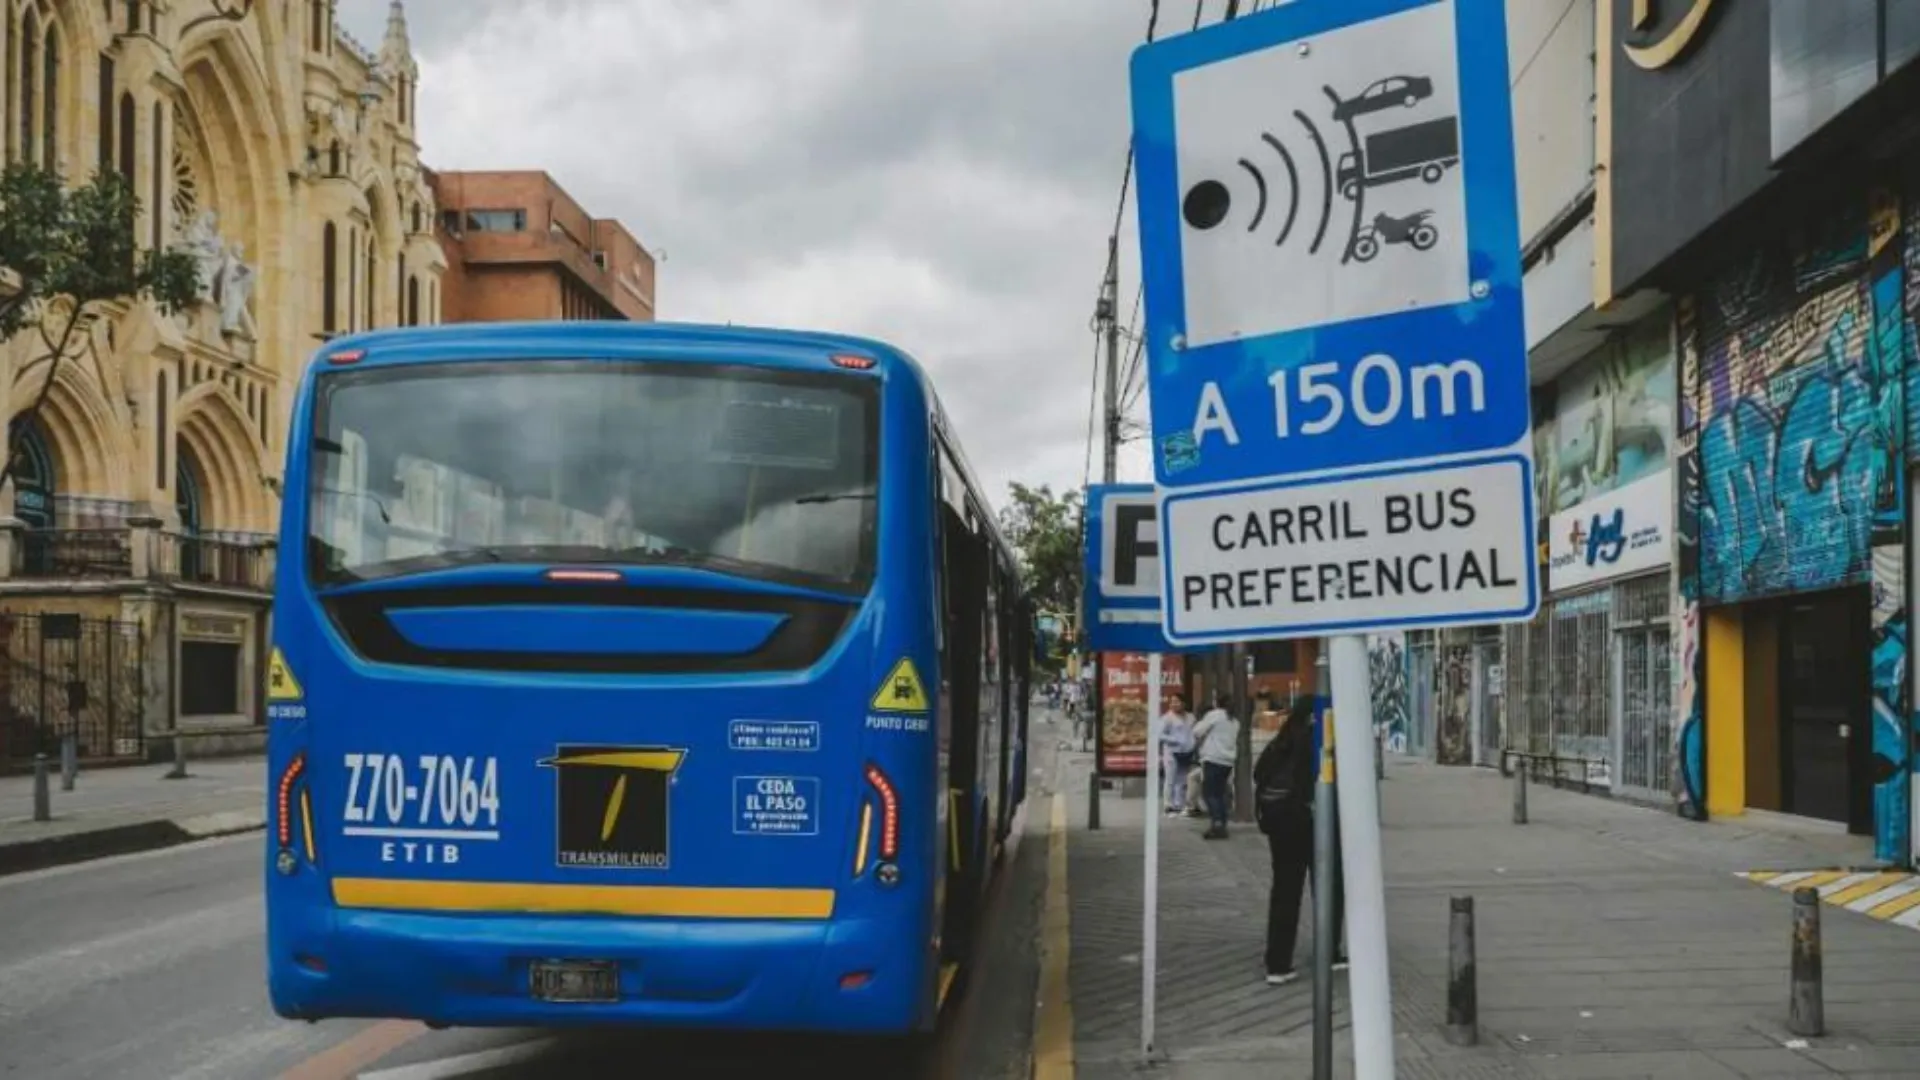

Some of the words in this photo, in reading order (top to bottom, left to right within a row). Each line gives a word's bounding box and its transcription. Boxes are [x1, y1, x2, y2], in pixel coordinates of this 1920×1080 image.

[1193, 382, 1239, 445] A
[1267, 353, 1484, 438] 150m
[1212, 501, 1368, 551] CARRIL
[1385, 487, 1476, 535] BUS
[1183, 548, 1518, 612] PREFERENCIAL
[865, 715, 902, 730] PUNTO
[344, 754, 499, 824] Z70-7064
[757, 780, 795, 795] CEDA
[746, 795, 762, 811] EL
[766, 796, 806, 811] PASO
[381, 842, 460, 863] ETIB
[560, 851, 666, 866] TRANSMILENIO
